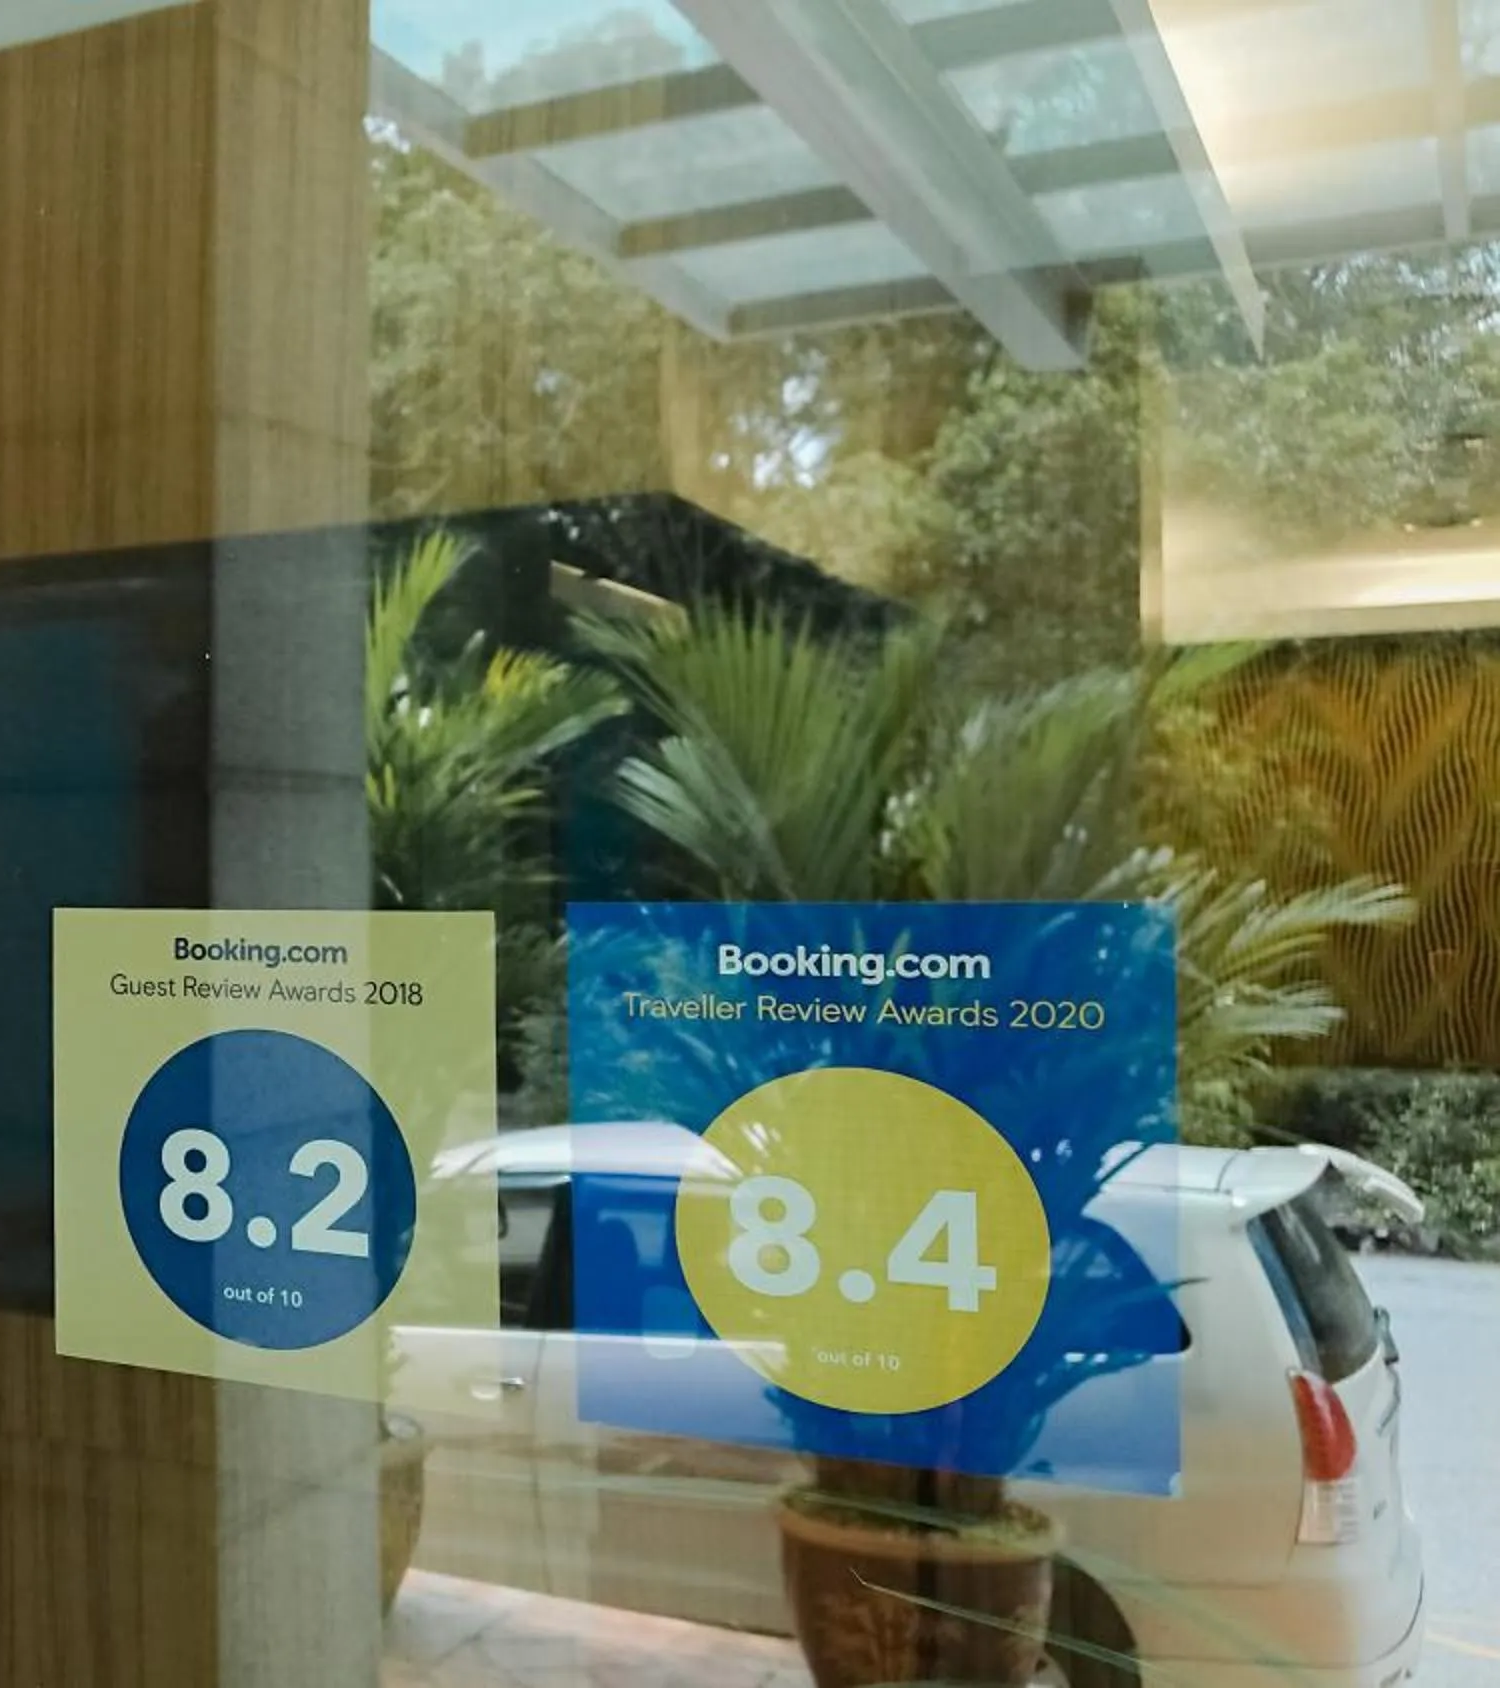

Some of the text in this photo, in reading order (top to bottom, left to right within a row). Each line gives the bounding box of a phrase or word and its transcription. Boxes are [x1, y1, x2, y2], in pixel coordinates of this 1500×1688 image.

[174, 937, 348, 968] Booking.com
[718, 943, 991, 985] Booking.com
[110, 973, 424, 1007] Guest Review Awards 2018
[622, 990, 1105, 1030] Traveller Review Awards 2020
[159, 1128, 370, 1259] 8.2
[728, 1174, 998, 1313] 8.4
[224, 1286, 302, 1307] out of 10
[817, 1351, 900, 1372] out of 10
